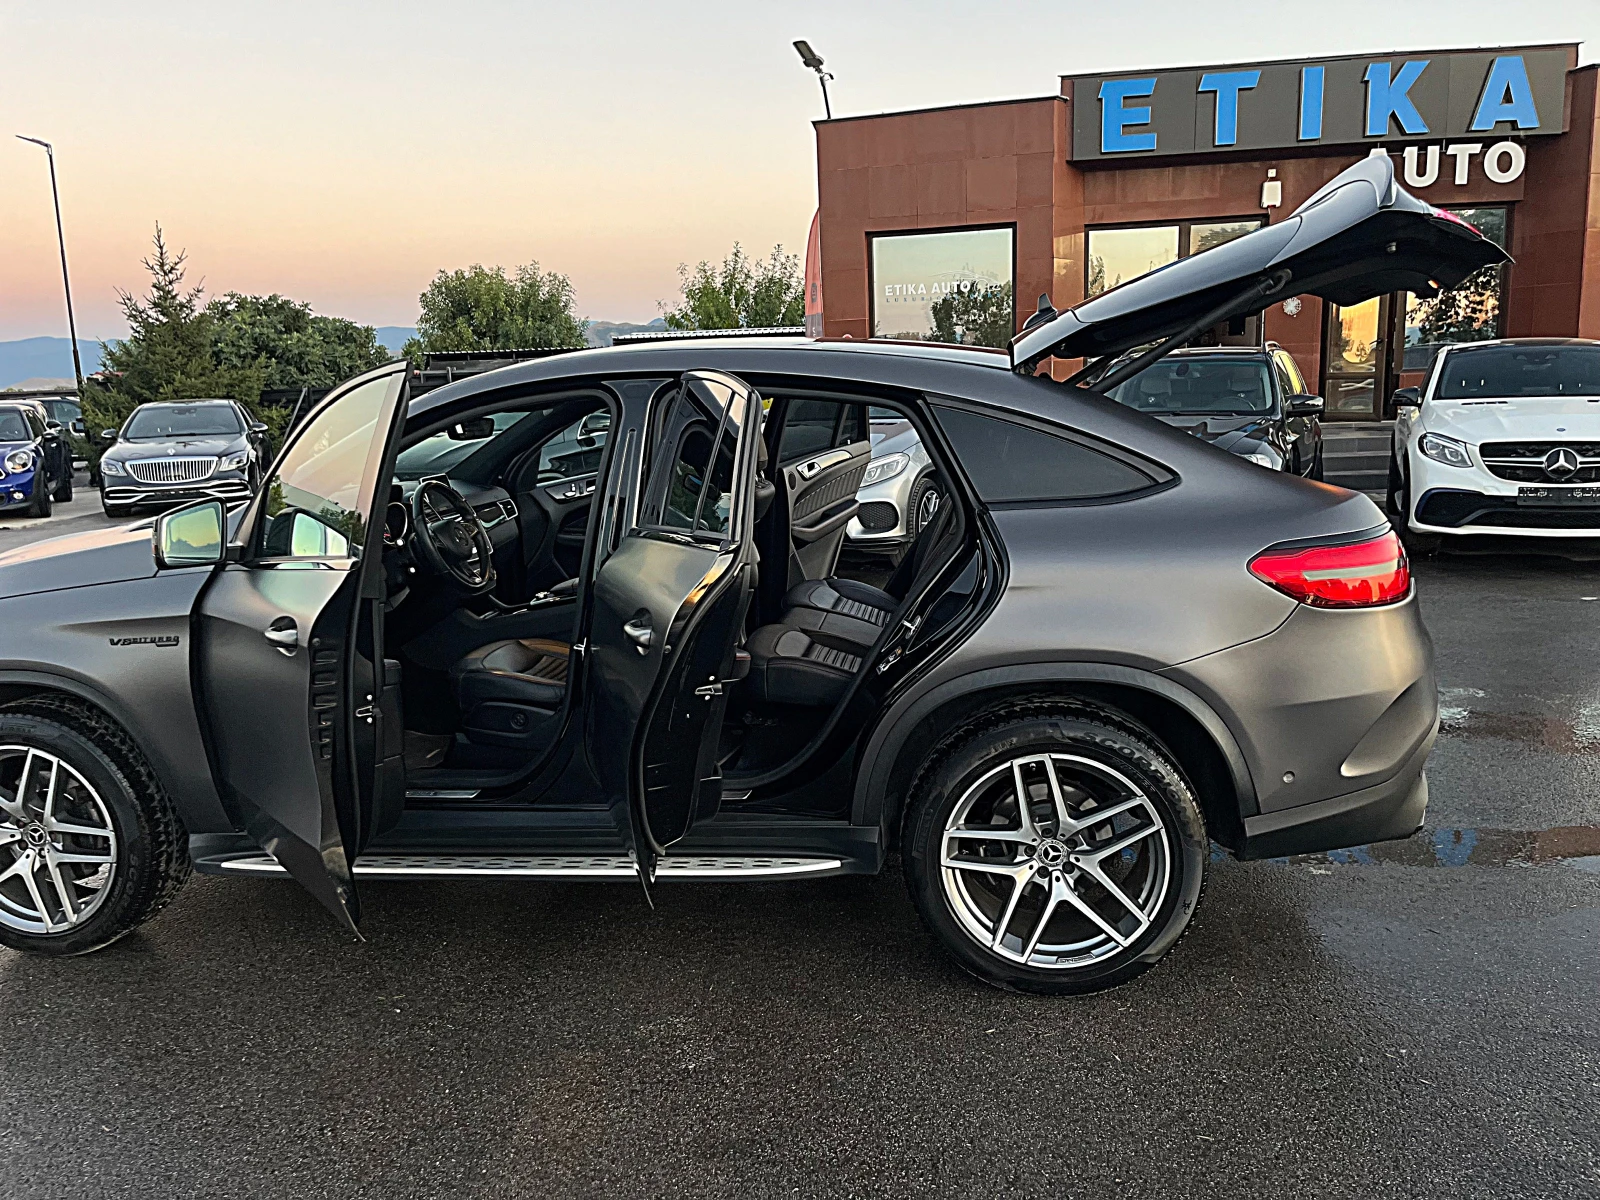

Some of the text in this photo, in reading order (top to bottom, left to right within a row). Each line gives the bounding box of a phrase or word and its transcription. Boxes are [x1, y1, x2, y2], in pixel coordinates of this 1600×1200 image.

[1099, 55, 1540, 153] ETIKA
[1369, 141, 1525, 188] UTO
[885, 281, 971, 296] ETIKA AUTO
